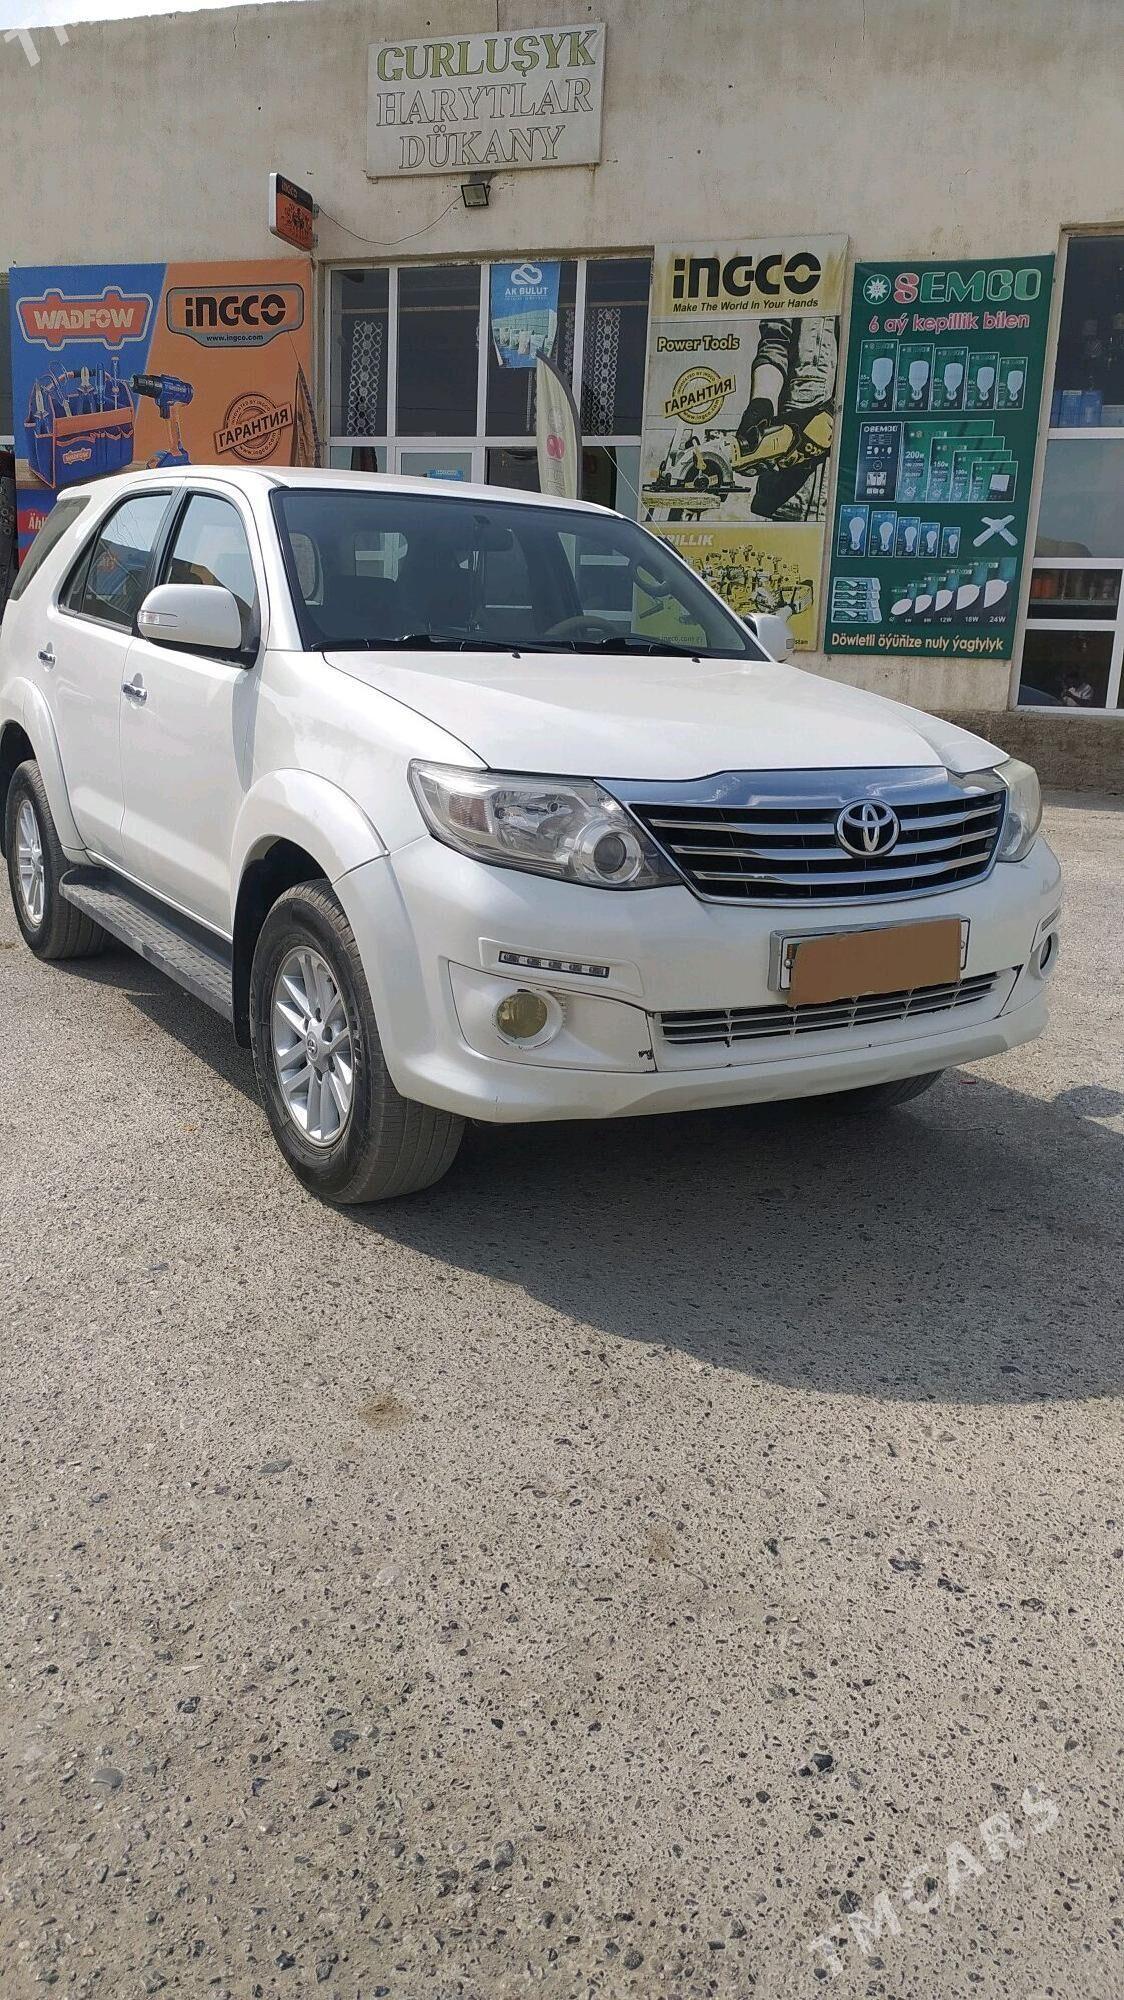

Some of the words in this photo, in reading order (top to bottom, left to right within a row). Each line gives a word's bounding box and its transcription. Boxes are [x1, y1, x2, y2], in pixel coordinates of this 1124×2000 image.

[376, 29, 597, 81] GURLUŞYK
[376, 77, 593, 126] HARYTLAR
[399, 124, 565, 169] DÜKANY
[505, 287, 517, 295] AK
[519, 286, 548, 295] BULUT
[893, 268, 1041, 304] SEMCO
[673, 303, 697, 312] Make
[701, 302, 717, 311] The
[721, 301, 748, 310] World
[751, 301, 759, 309] In
[763, 299, 785, 309] Your
[788, 298, 818, 308] Hands
[33, 308, 134, 330] WADFOW
[868, 316, 880, 333] 6
[884, 312, 908, 335] aý
[912, 312, 978, 335] kepillik
[983, 311, 1030, 330] bilen
[206, 333, 264, 343] www.ingco.com
[657, 336, 701, 352] Power
[702, 334, 740, 350] Tools
[665, 379, 732, 413] ГАРАНТИЯ
[219, 408, 288, 447] ГАРАНТИЯ
[832, 633, 875, 648] Döwletli
[925, 637, 950, 651] nuly
[952, 635, 1003, 653] ýagtylyk
